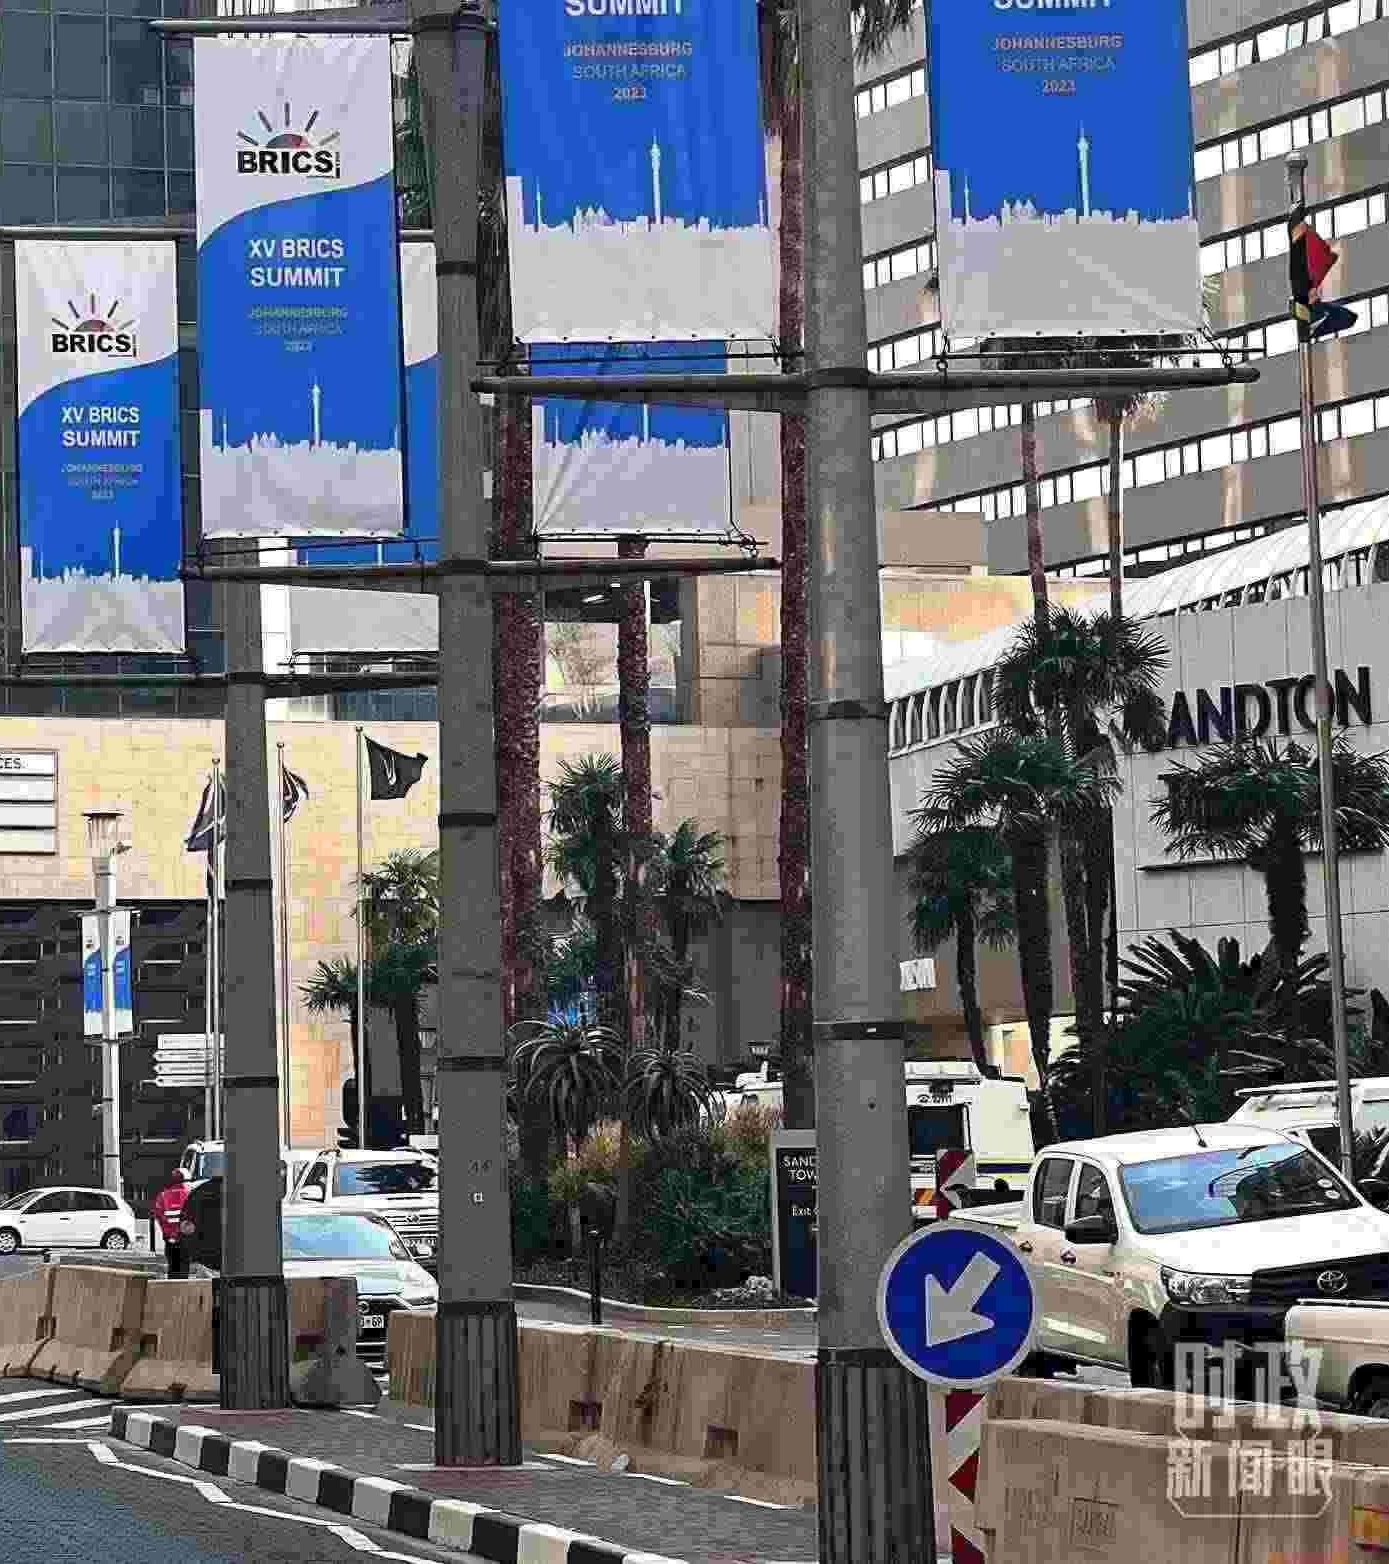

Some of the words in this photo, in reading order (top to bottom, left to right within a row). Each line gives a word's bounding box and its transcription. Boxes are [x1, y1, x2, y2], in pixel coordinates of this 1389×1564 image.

[563, 42, 692, 57] JOHANNESBURG
[991, 34, 1123, 49] JOHANNESBURG
[237, 151, 333, 174] BRICS
[250, 239, 276, 258] XV
[282, 239, 344, 258] BRICS
[250, 267, 346, 287] SUMMIT
[52, 334, 131, 353] BRICS
[61, 406, 84, 423] XV
[89, 406, 141, 423] BRICS
[62, 430, 141, 447] SUMMIT
[1163, 666, 1373, 747] ANDTON
